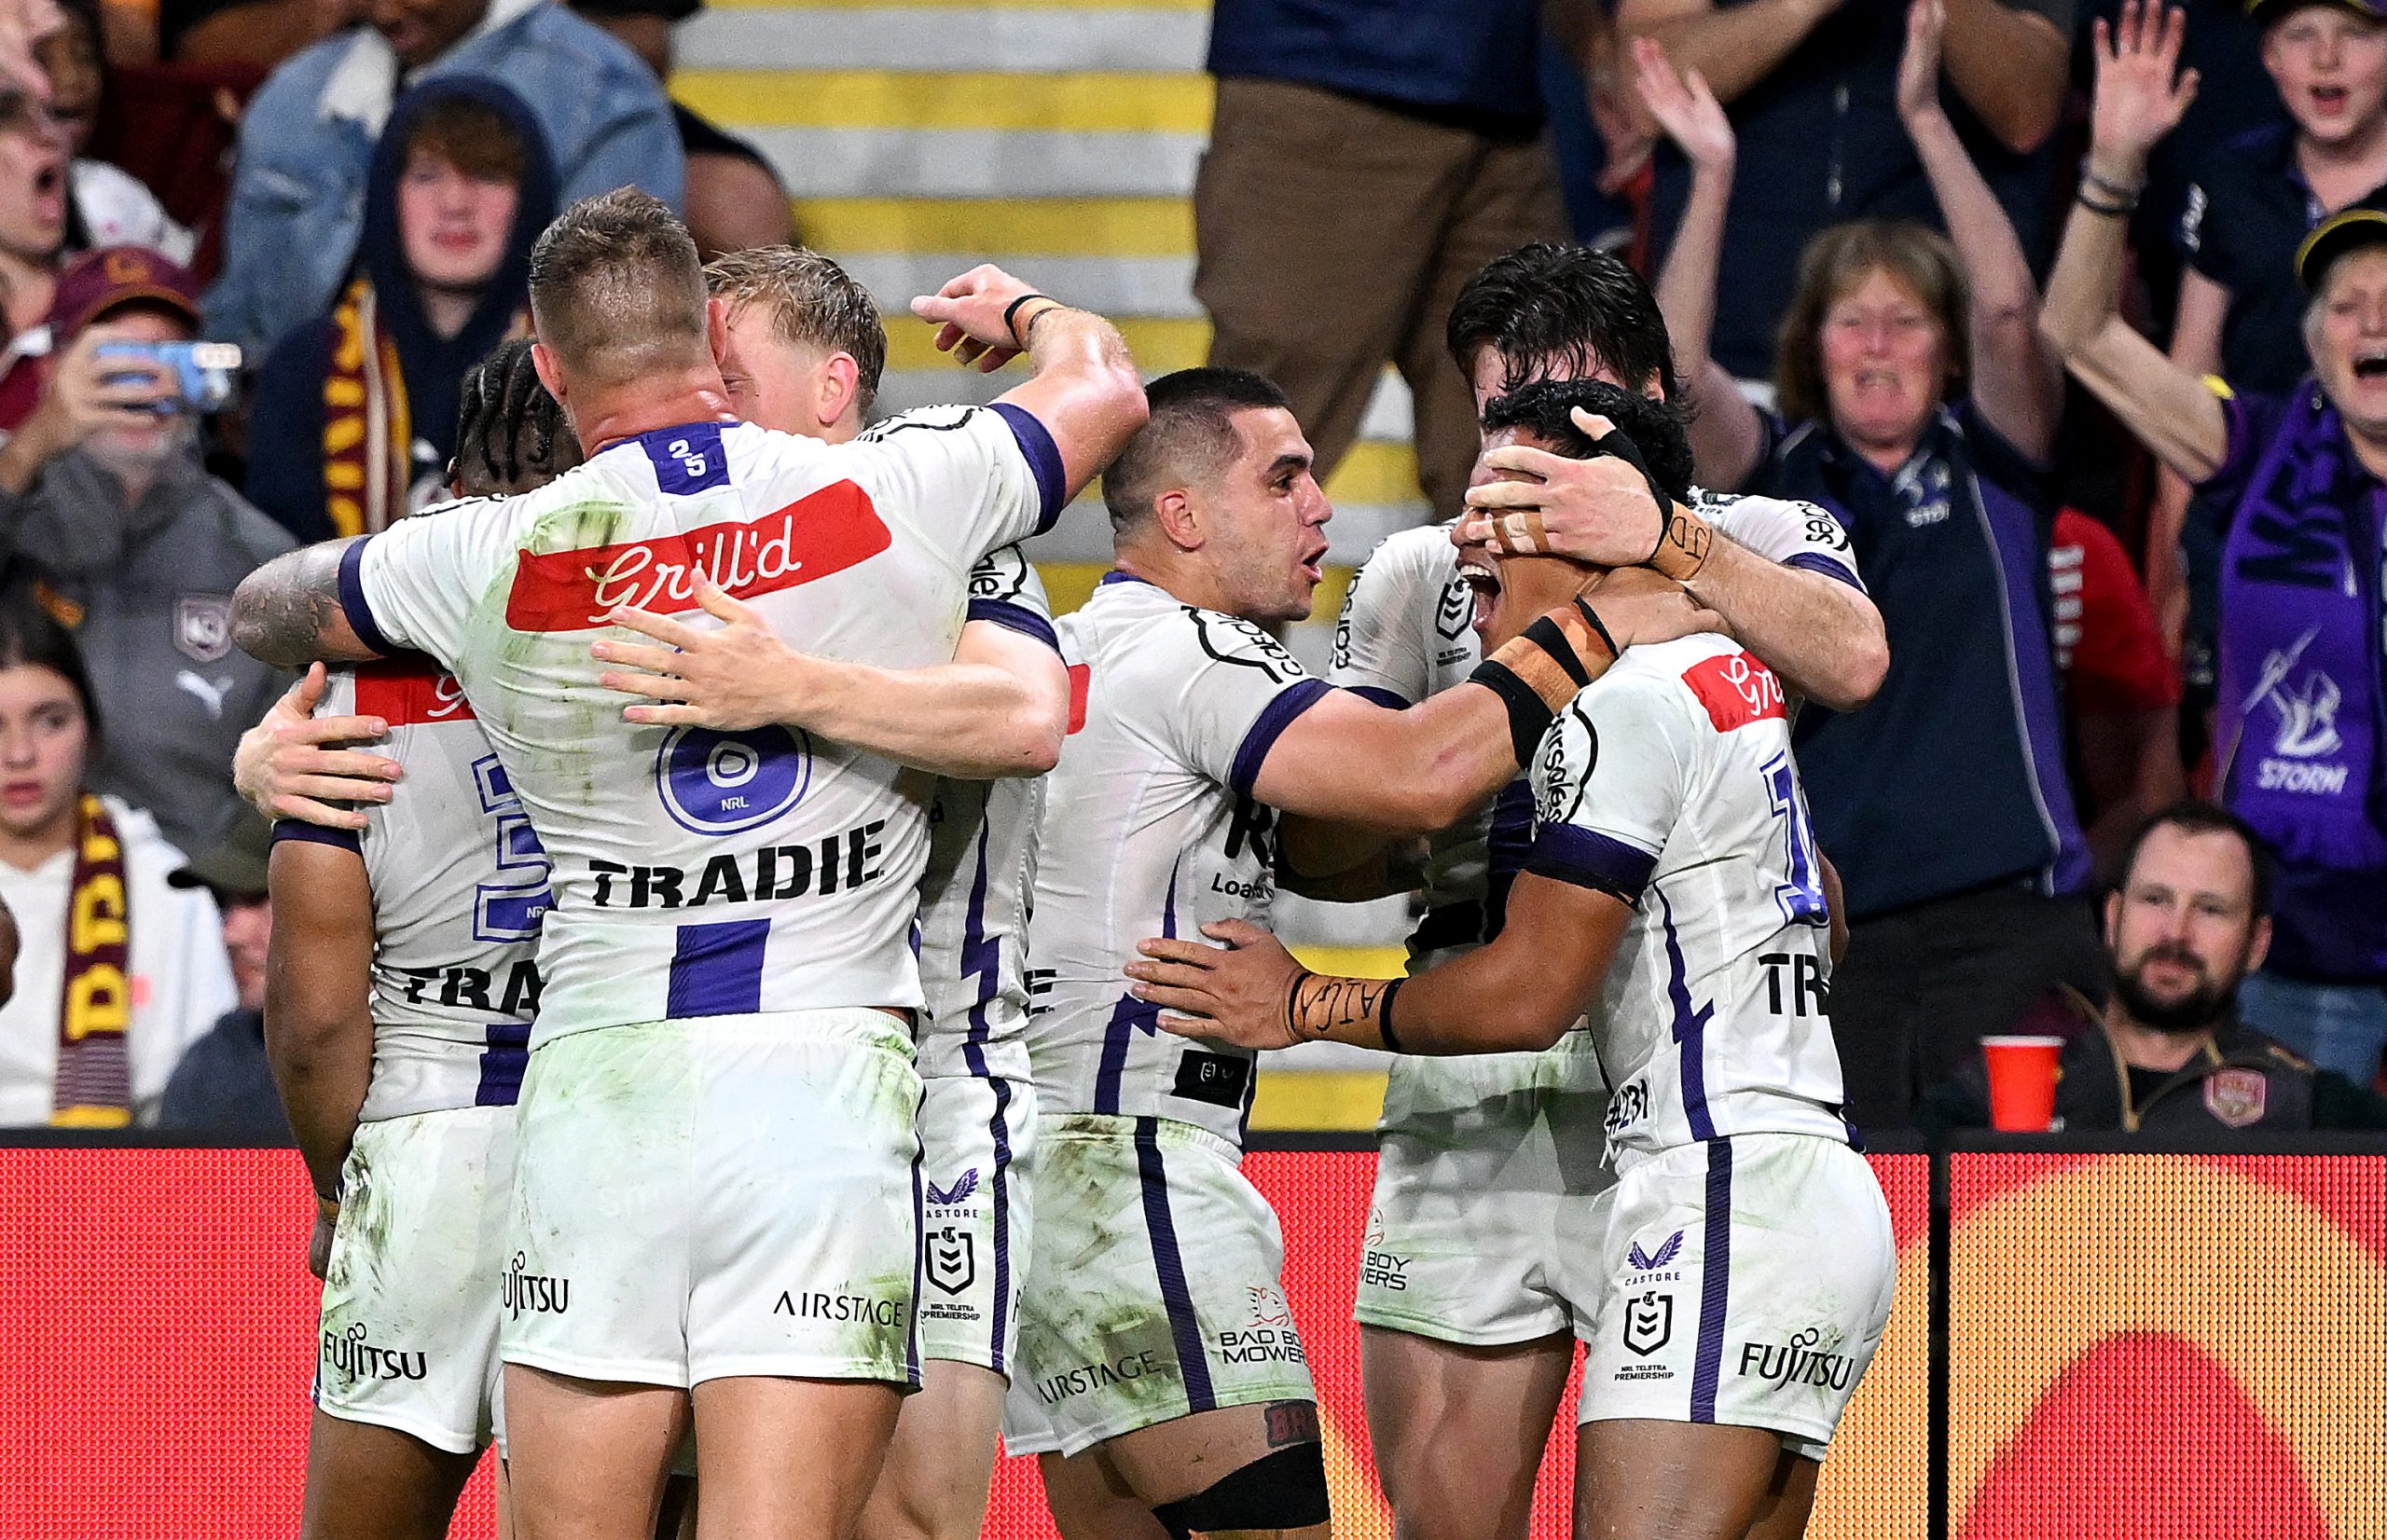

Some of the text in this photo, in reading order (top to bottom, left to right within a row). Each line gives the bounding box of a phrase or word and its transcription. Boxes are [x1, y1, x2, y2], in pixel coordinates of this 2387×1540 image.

[585, 515, 803, 623] Grill'd
[2257, 758, 2349, 794] STORM
[721, 796, 750, 811] NRL
[588, 818, 886, 908] TRADIE
[926, 1209, 979, 1219] ASTORE
[1366, 1251, 1413, 1272] BOY
[501, 1250, 570, 1322] UJITSU
[1624, 1272, 1681, 1286] CASTORE
[773, 1290, 904, 1327] AIRSTAGE
[324, 1321, 428, 1383] FUJITSU
[1220, 1330, 1276, 1346] BAD
[1222, 1345, 1306, 1365] MOWER
[1738, 1327, 1856, 1392] FUJITSU
[1614, 1371, 1675, 1382] PREMIERSHIP
